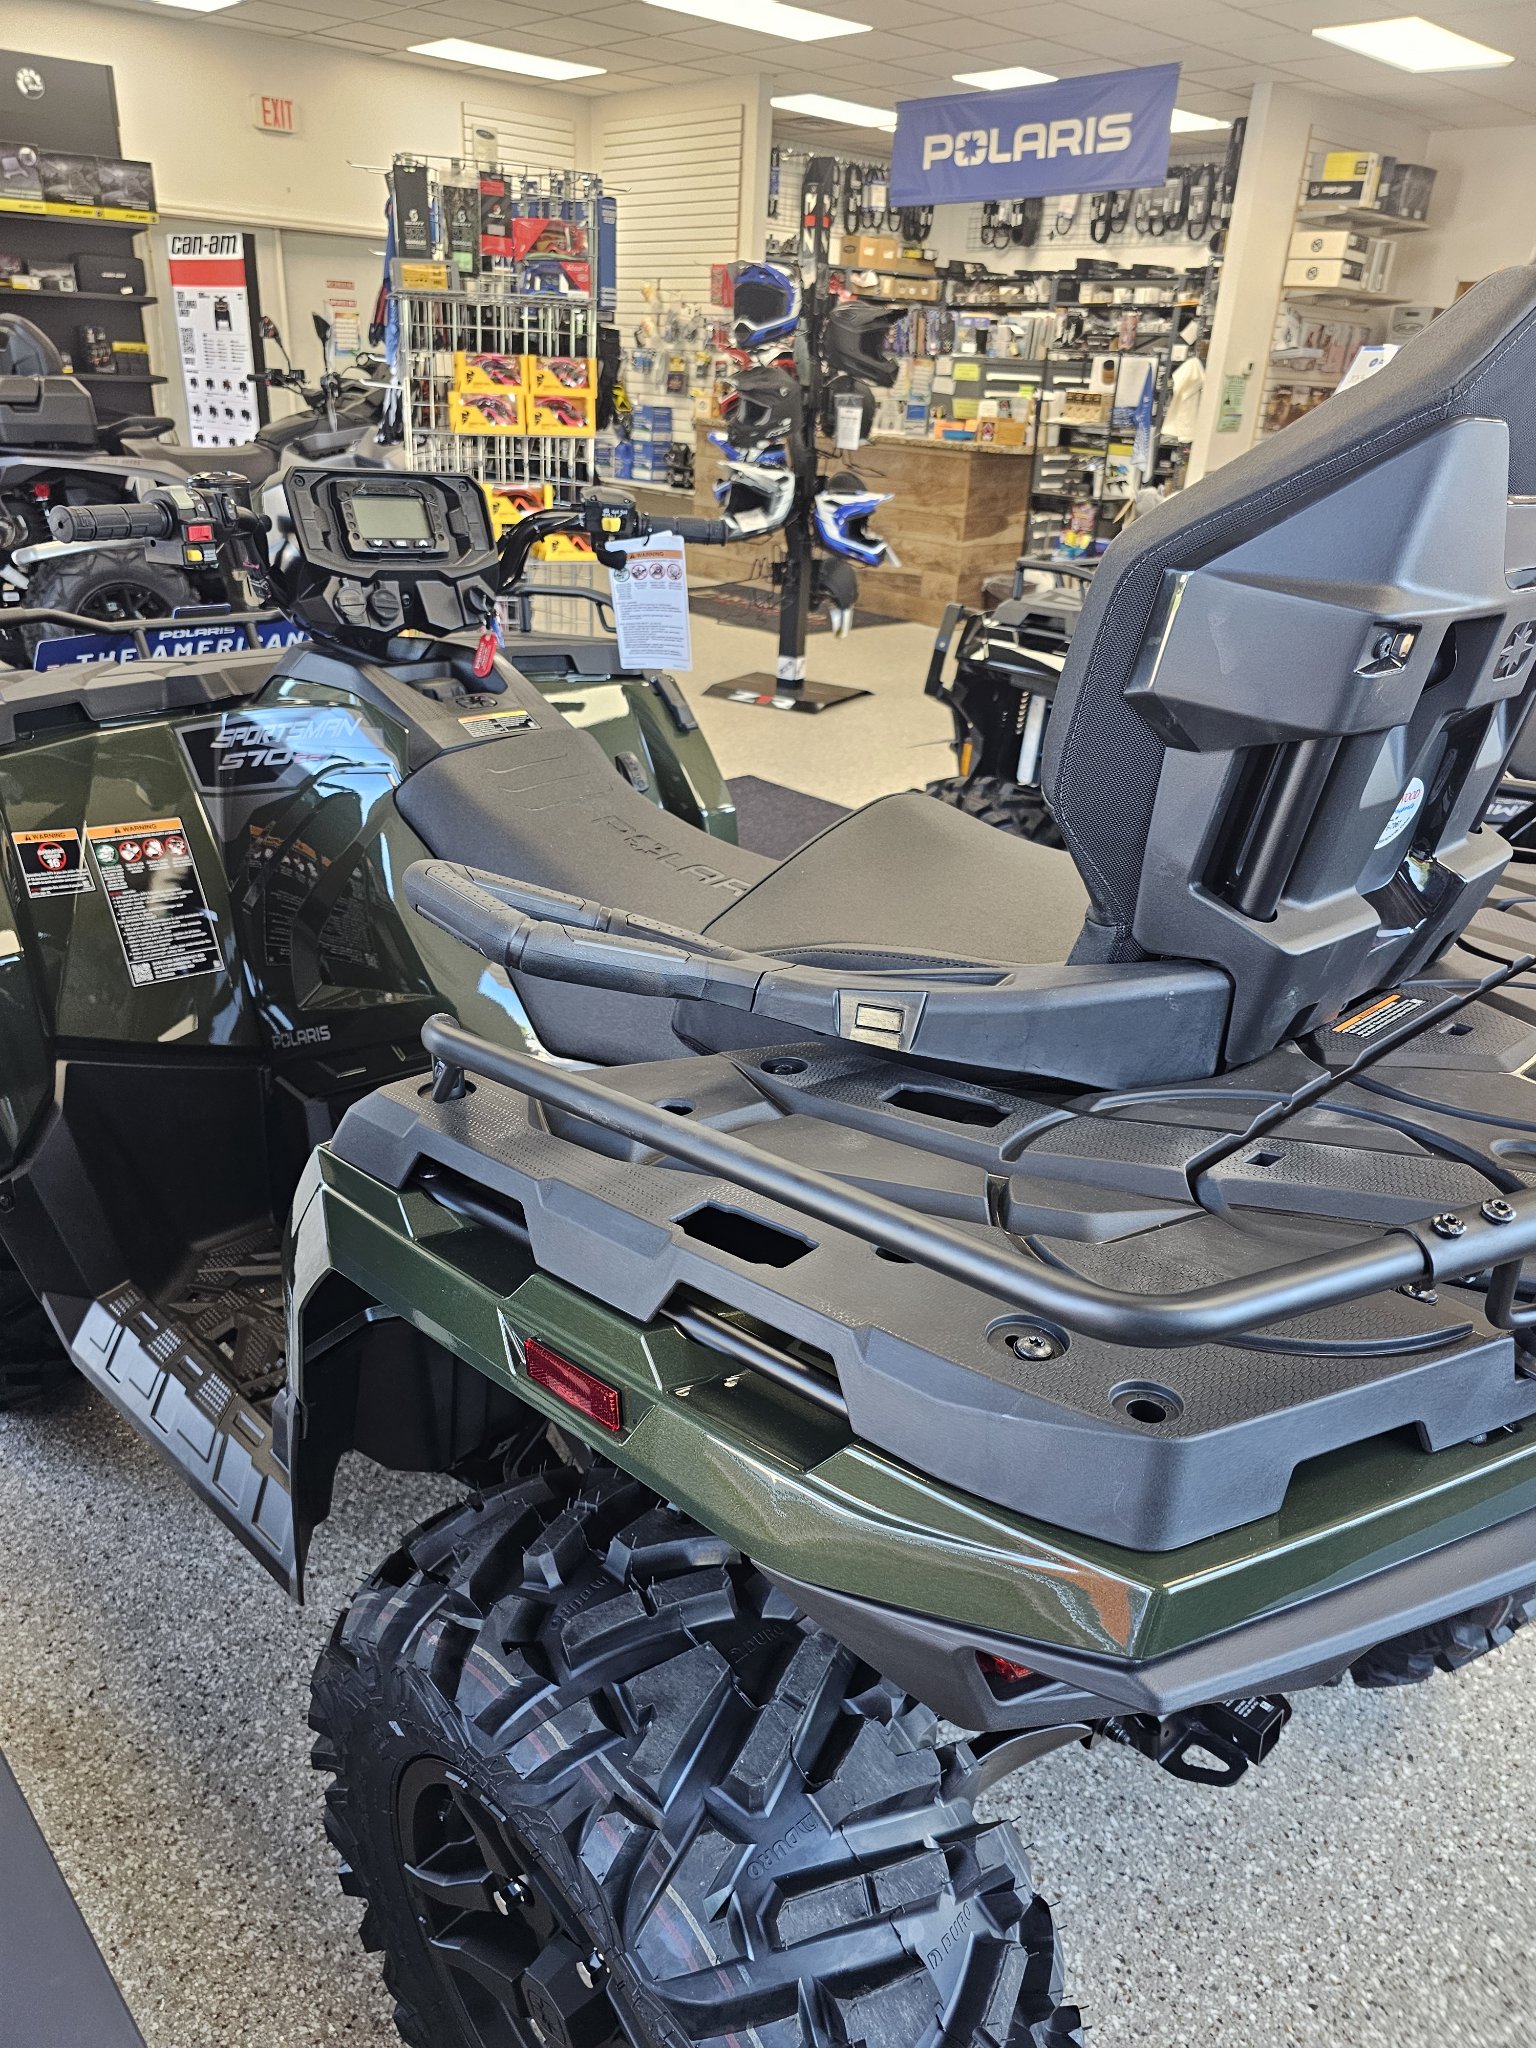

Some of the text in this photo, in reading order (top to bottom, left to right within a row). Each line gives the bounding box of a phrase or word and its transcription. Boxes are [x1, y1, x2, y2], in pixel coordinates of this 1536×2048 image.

[262, 97, 293, 130] EXIT
[922, 112, 1134, 171] POLARIS
[171, 235, 237, 255] can-am
[159, 627, 236, 641] POLARIS
[210, 717, 363, 749] SPORTSMAN
[218, 749, 296, 771] 570
[123, 824, 157, 833] WARNING
[46, 858, 61, 868] 16
[272, 1025, 331, 1049] POLARIS
[746, 1825, 800, 1881] DURO
